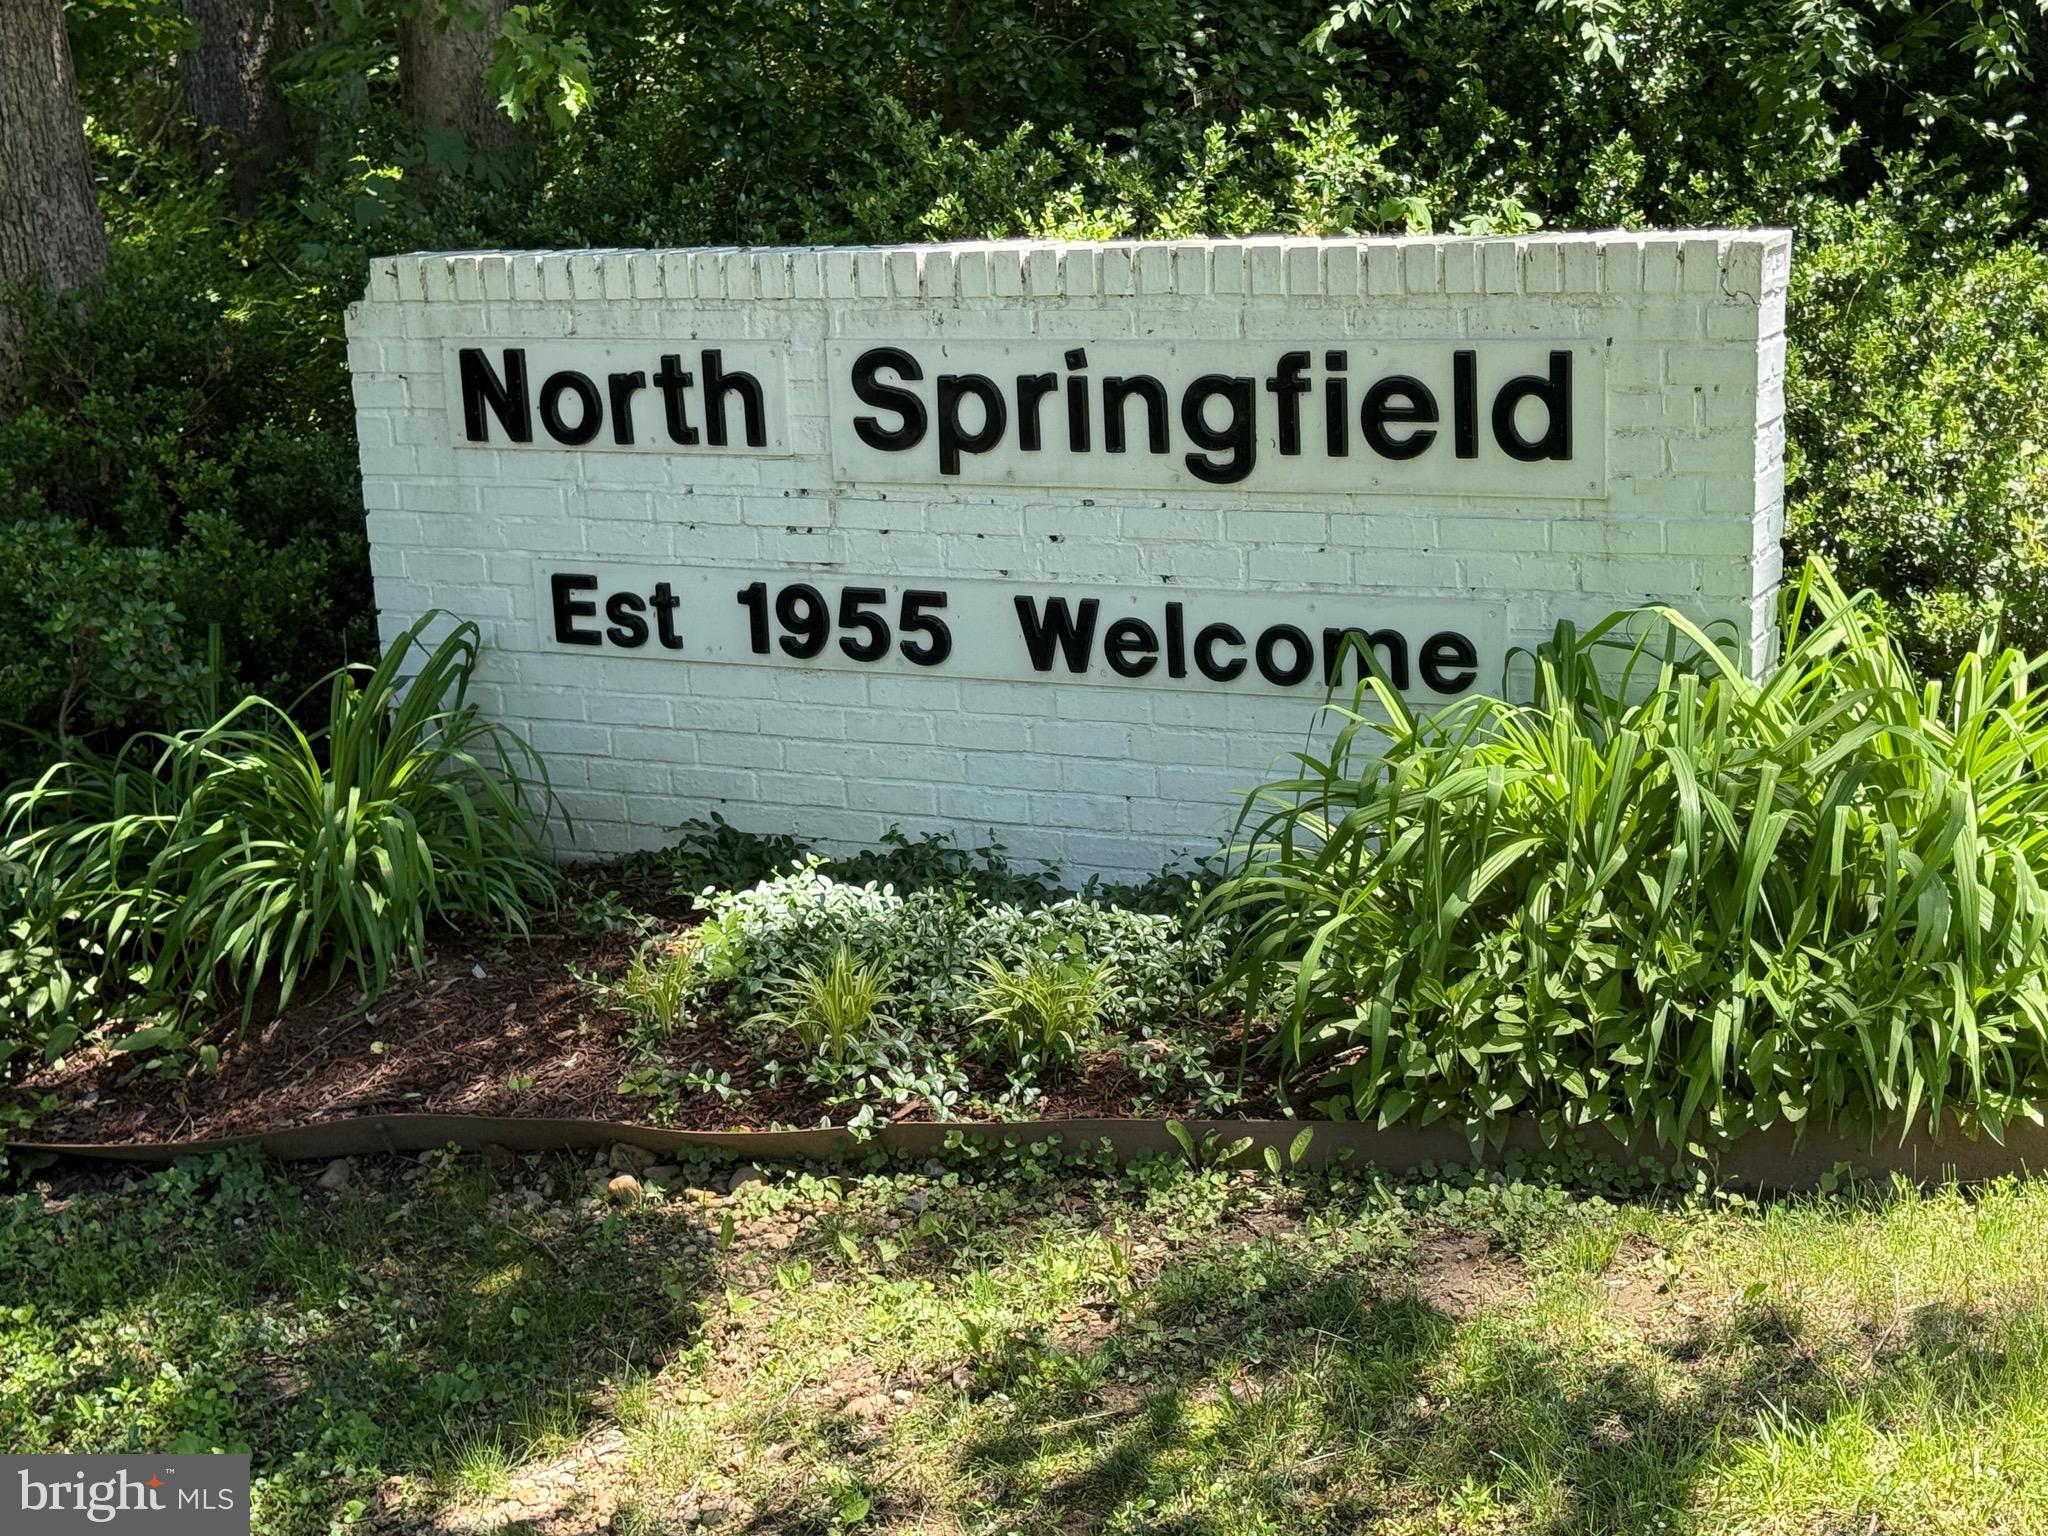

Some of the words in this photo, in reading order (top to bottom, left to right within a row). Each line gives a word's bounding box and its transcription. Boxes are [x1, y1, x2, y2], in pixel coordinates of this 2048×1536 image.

[458, 348, 768, 449] North
[851, 346, 1574, 486] Springfield
[550, 572, 685, 651] Est
[736, 581, 953, 668] 1955
[1012, 594, 1480, 696] Welcome
